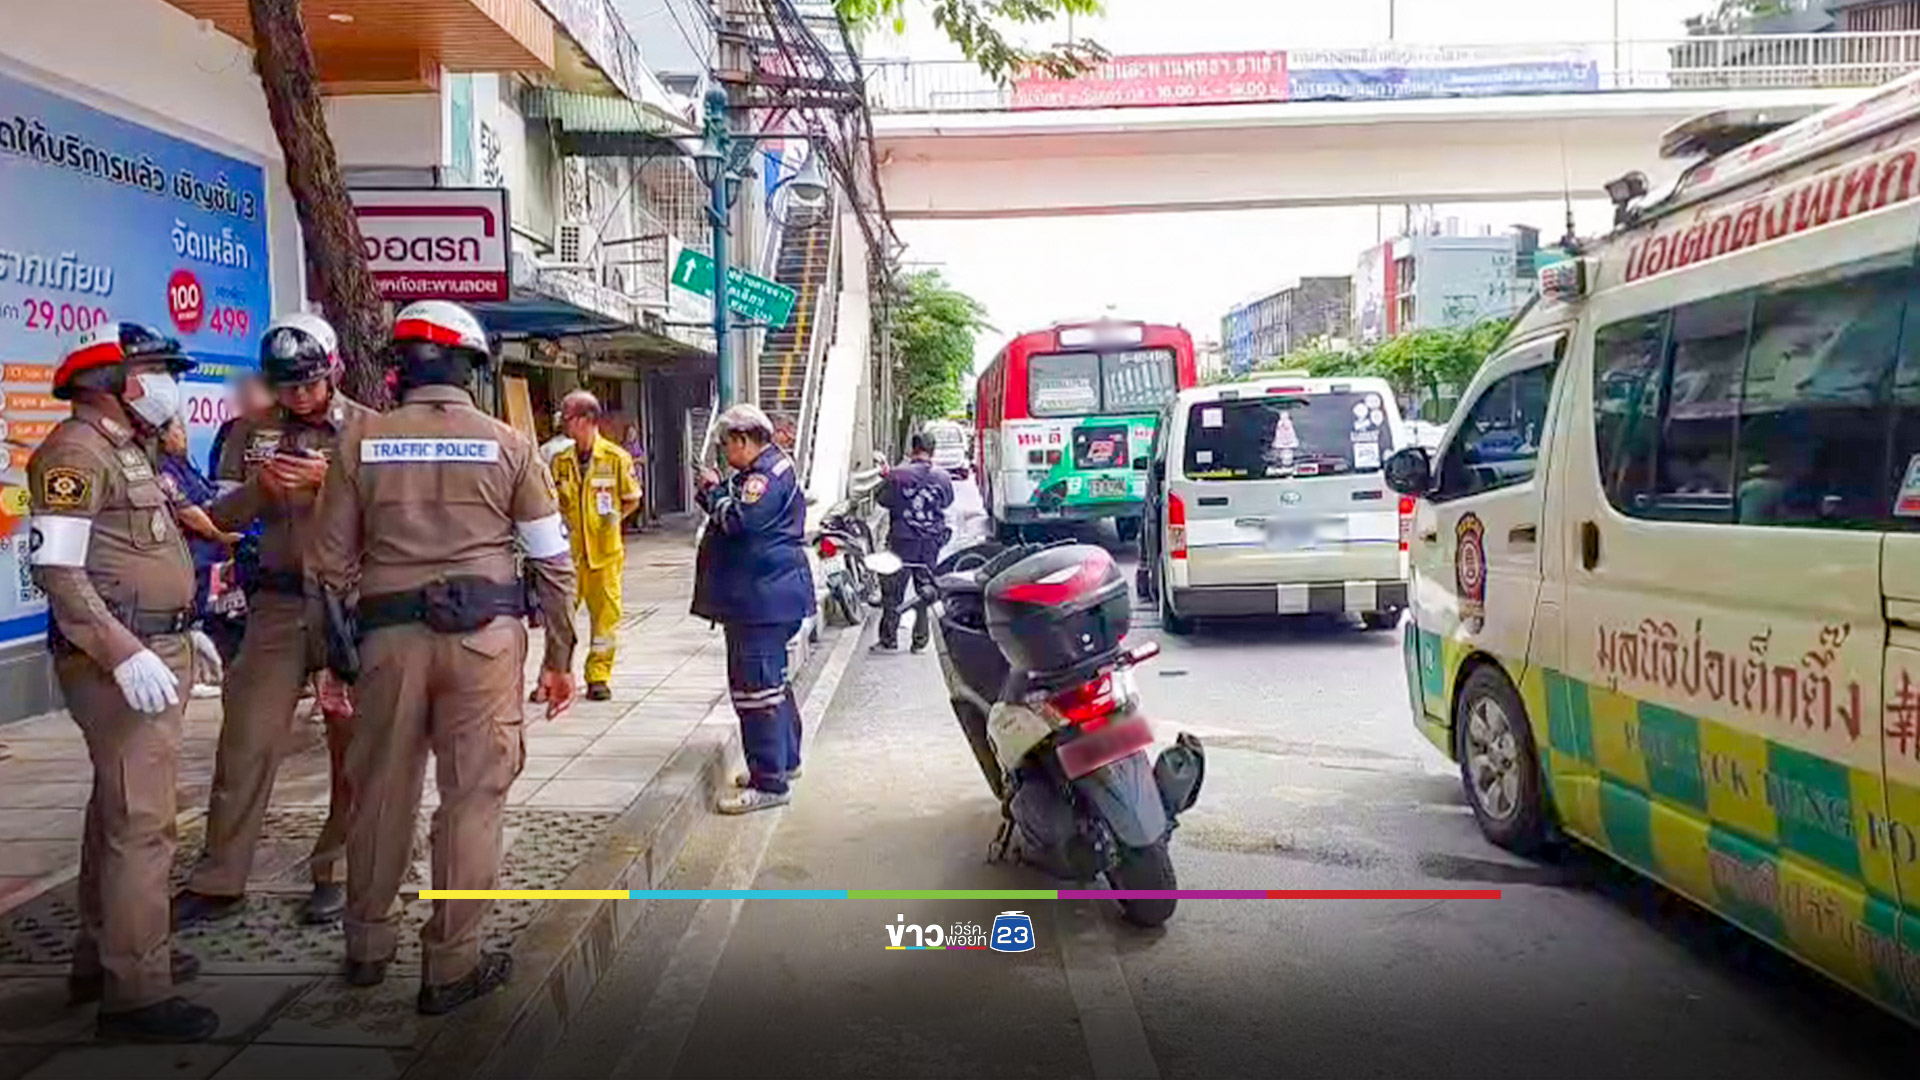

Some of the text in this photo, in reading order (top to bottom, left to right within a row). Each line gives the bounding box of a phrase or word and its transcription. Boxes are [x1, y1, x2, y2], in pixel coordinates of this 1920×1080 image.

[244, 193, 255, 218] 3
[171, 218, 249, 268] จัดเหล็ก
[170, 284, 200, 311] 100
[210, 305, 248, 337] 499
[372, 443, 487, 458] TRAFFIC POLICE
